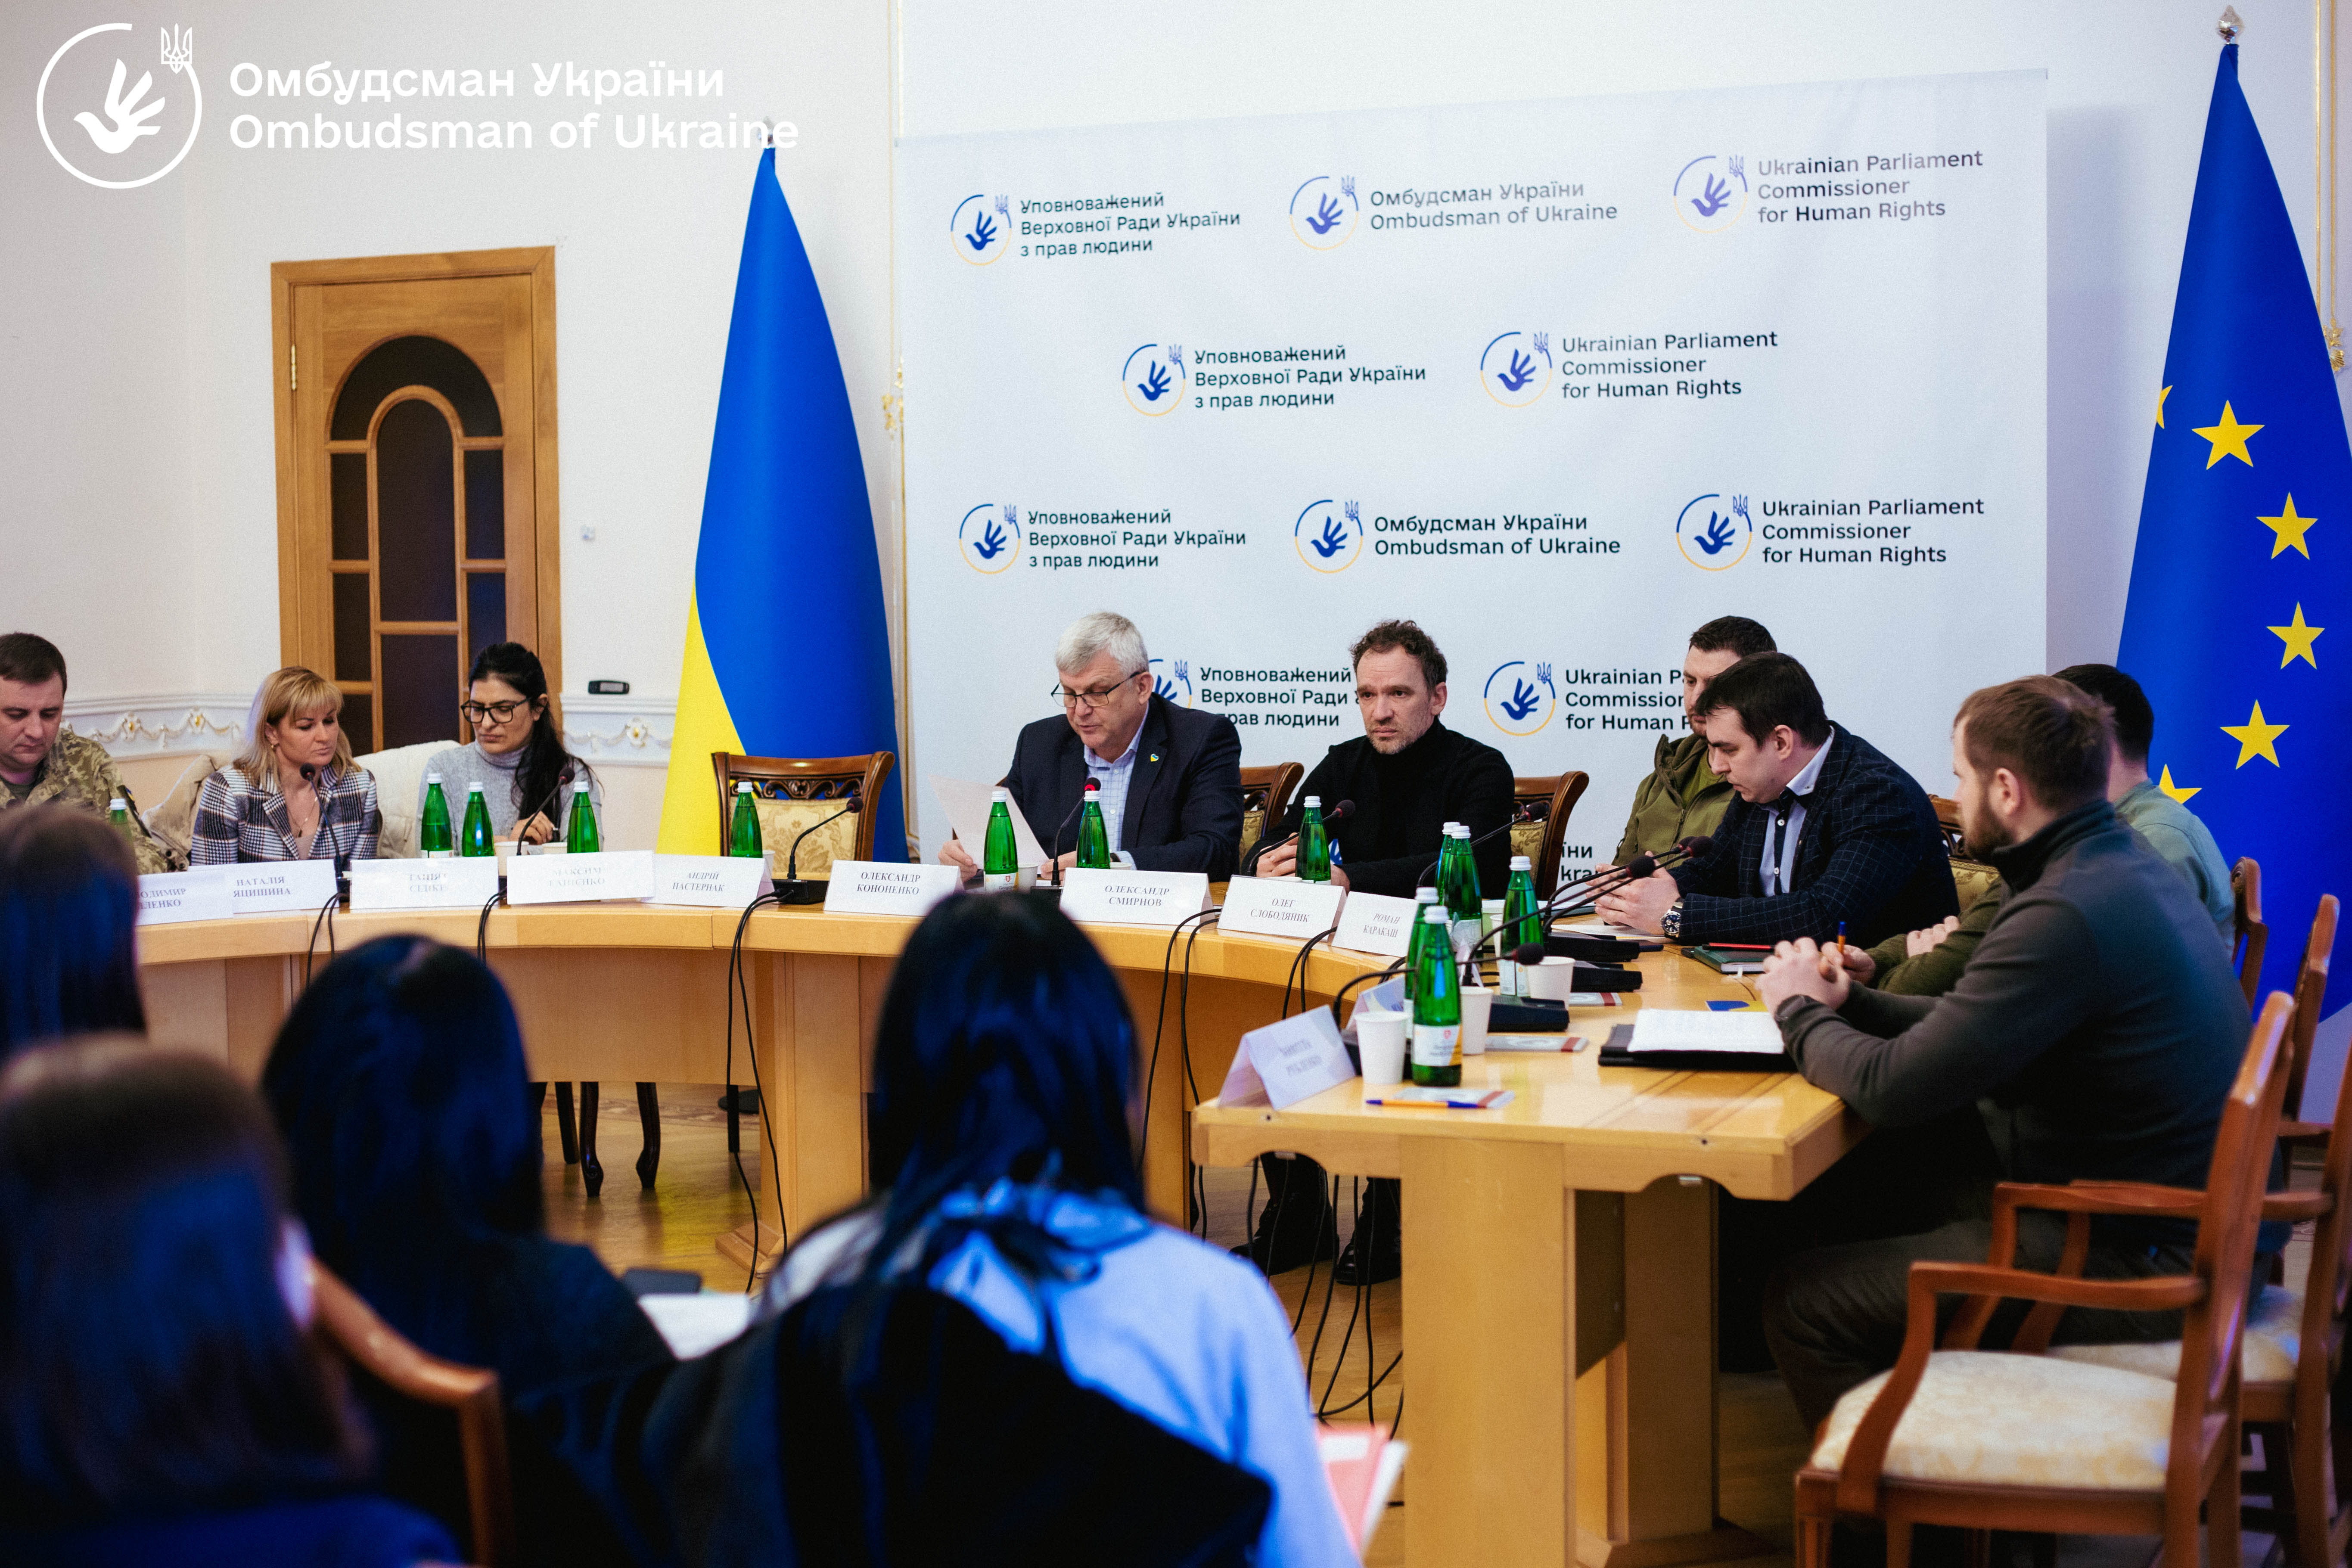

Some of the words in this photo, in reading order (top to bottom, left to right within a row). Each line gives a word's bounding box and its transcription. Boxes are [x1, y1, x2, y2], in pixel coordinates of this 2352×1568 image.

[1760, 157, 1858, 175] Ukrainian
[1867, 151, 1983, 171] Parliament
[1370, 189, 1491, 208] Омбудсман
[1500, 181, 1584, 203] України
[1759, 180, 1909, 199] Commissioner
[1021, 193, 1163, 214] Уповноважений
[1371, 211, 1499, 230] Ombudsman
[1507, 206, 1529, 224] of
[1536, 204, 1618, 223] Ukraine
[1758, 207, 1788, 223] for
[1796, 206, 1870, 221] Human
[1880, 201, 1945, 221] Rights
[1022, 217, 1111, 237] Верховної
[1118, 217, 1159, 231] Ради
[1167, 211, 1240, 230] України
[1021, 245, 1029, 257] з
[1036, 244, 1077, 258] прав
[1083, 240, 1152, 255] людини
[1563, 335, 1656, 353] Ukrainian
[1665, 332, 1777, 349] Parliament
[1195, 345, 1345, 364] Уповноважений
[1563, 357, 1706, 376] Commissioner
[1196, 369, 1290, 388] Верховної
[1297, 369, 1342, 385] Ради
[1349, 366, 1425, 384] України
[1562, 383, 1590, 398] for
[1598, 383, 1668, 397] Human
[1677, 379, 1741, 399] Rights
[1195, 397, 1203, 408] з
[1210, 396, 1253, 410] прав
[1259, 394, 1334, 407] людини
[1763, 500, 1860, 516] Ukrainian
[1869, 499, 1984, 515] Parliament
[1028, 509, 1171, 525] Уповноважений
[1375, 515, 1495, 535] Омбудсман
[1503, 514, 1587, 534] України
[1029, 531, 1117, 549] Верховної
[1123, 531, 1167, 547] Ради
[1174, 530, 1246, 548] України
[1763, 523, 1911, 540] Commissioner
[1375, 539, 1503, 555] Ombudsman
[1511, 537, 1533, 554] of
[1540, 537, 1621, 554] Ukraine
[1030, 556, 1037, 567] з
[1043, 556, 1082, 570] прав
[1088, 556, 1158, 569] людини
[1763, 547, 1792, 562] for
[1800, 548, 1871, 562] Human
[1880, 546, 1946, 566] Rights
[1200, 668, 1351, 682] Уповноважений
[1566, 669, 1661, 684] Ukrainian
[1202, 689, 1296, 706] Верховної
[1303, 690, 1347, 706] Ради
[1566, 692, 1684, 707] Commissio
[1218, 713, 1259, 725] рав
[1265, 714, 1339, 728] людини
[1566, 714, 1595, 729] for
[1603, 715, 1673, 730] Human
[236, 876, 285, 886] НАТАЛІЯ
[861, 872, 920, 882] ОЛЕКСАНДР
[140, 888, 186, 898] ОДИМИР
[233, 888, 291, 897] ЯЦИШИНА
[672, 882, 725, 891] ПАСТЕРНАК
[857, 884, 919, 894] КОНОНЕНКО
[1105, 886, 1170, 895] ОЛЕКСАНДР
[1109, 897, 1162, 906] СМИРНОВ
[1272, 898, 1296, 907] ОЛЕГ
[1250, 910, 1310, 922] СЛОБОДЯНИК
[1373, 913, 1401, 924] РОМАН
[1363, 925, 1398, 938] КАРАКАШ
